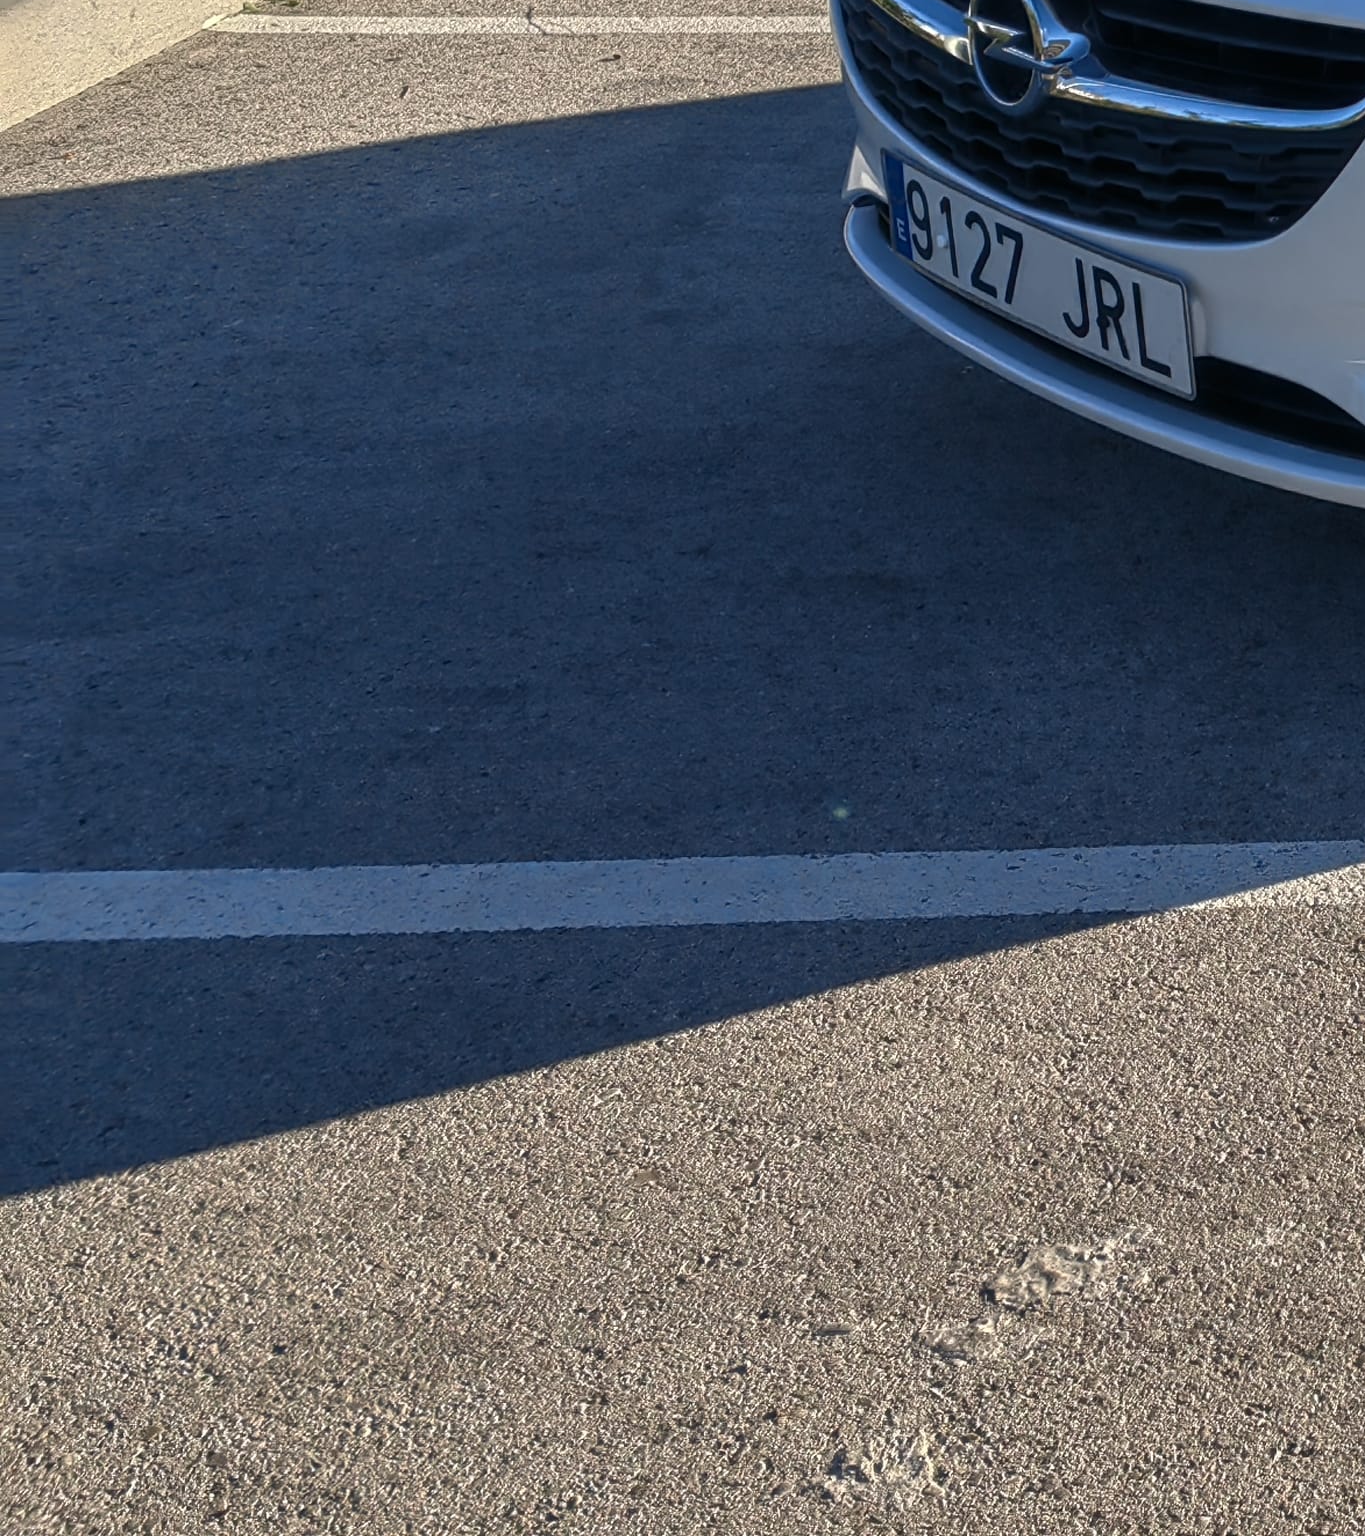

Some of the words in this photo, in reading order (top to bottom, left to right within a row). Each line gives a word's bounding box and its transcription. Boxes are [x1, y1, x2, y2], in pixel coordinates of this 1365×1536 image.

[895, 218, 908, 243] E
[905, 178, 1024, 306] 9127
[1062, 257, 1172, 379] JRL
